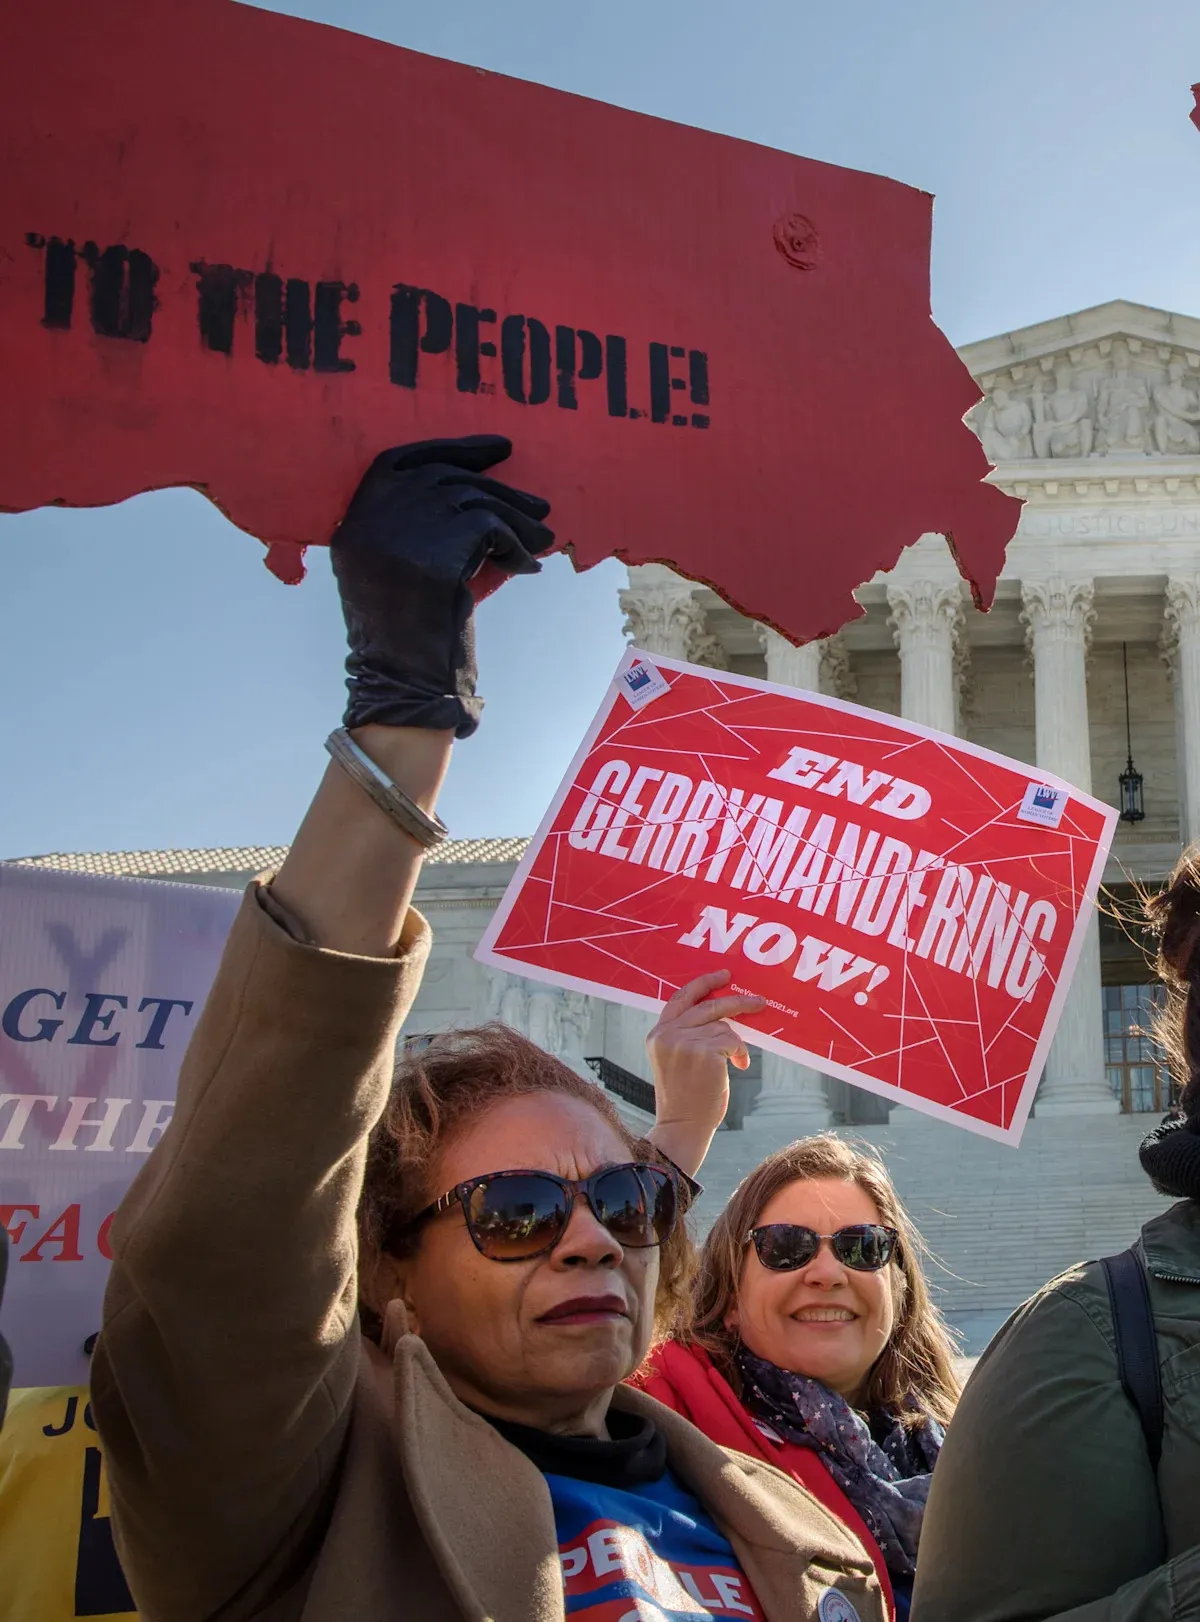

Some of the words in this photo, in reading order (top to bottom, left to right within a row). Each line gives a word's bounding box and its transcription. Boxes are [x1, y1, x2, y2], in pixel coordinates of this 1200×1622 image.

[25, 232, 159, 343] TO
[190, 261, 361, 373] THE
[390, 283, 709, 428] PEOPLE!
[766, 746, 932, 822] END
[568, 760, 1058, 1003] GERRYMANDERING
[677, 905, 890, 1006] NOW!
[1, 988, 194, 1050] GET
[0, 1093, 176, 1153] THE
